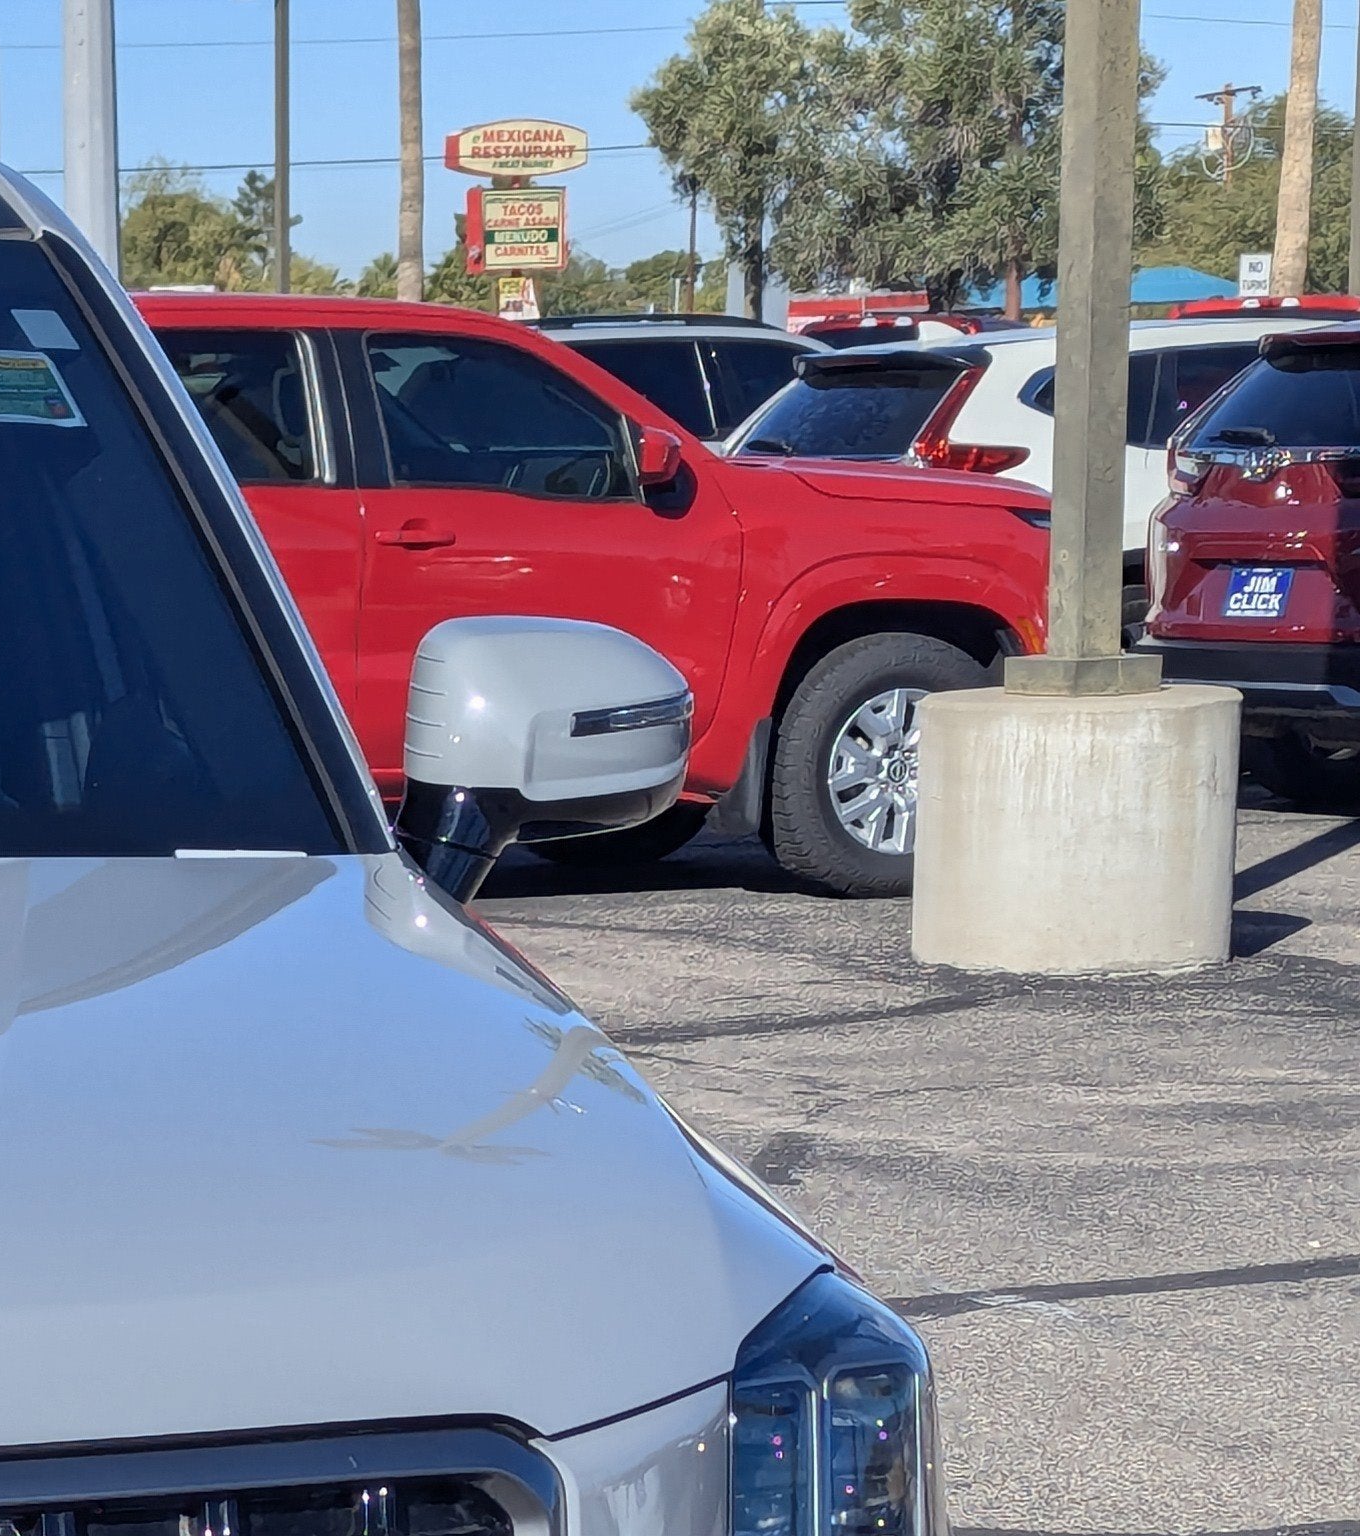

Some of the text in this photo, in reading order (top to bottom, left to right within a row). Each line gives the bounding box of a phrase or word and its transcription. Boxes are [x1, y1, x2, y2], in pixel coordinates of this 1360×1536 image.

[483, 130, 565, 142] MEXICANA
[471, 145, 576, 158] RESTAURANT
[502, 203, 543, 216] TACOS
[494, 229, 548, 242] MENUDO
[495, 245, 549, 257] CARNITAS
[1248, 261, 1263, 273] NO
[1243, 575, 1277, 593] JIM
[1230, 593, 1283, 610] CLICK
